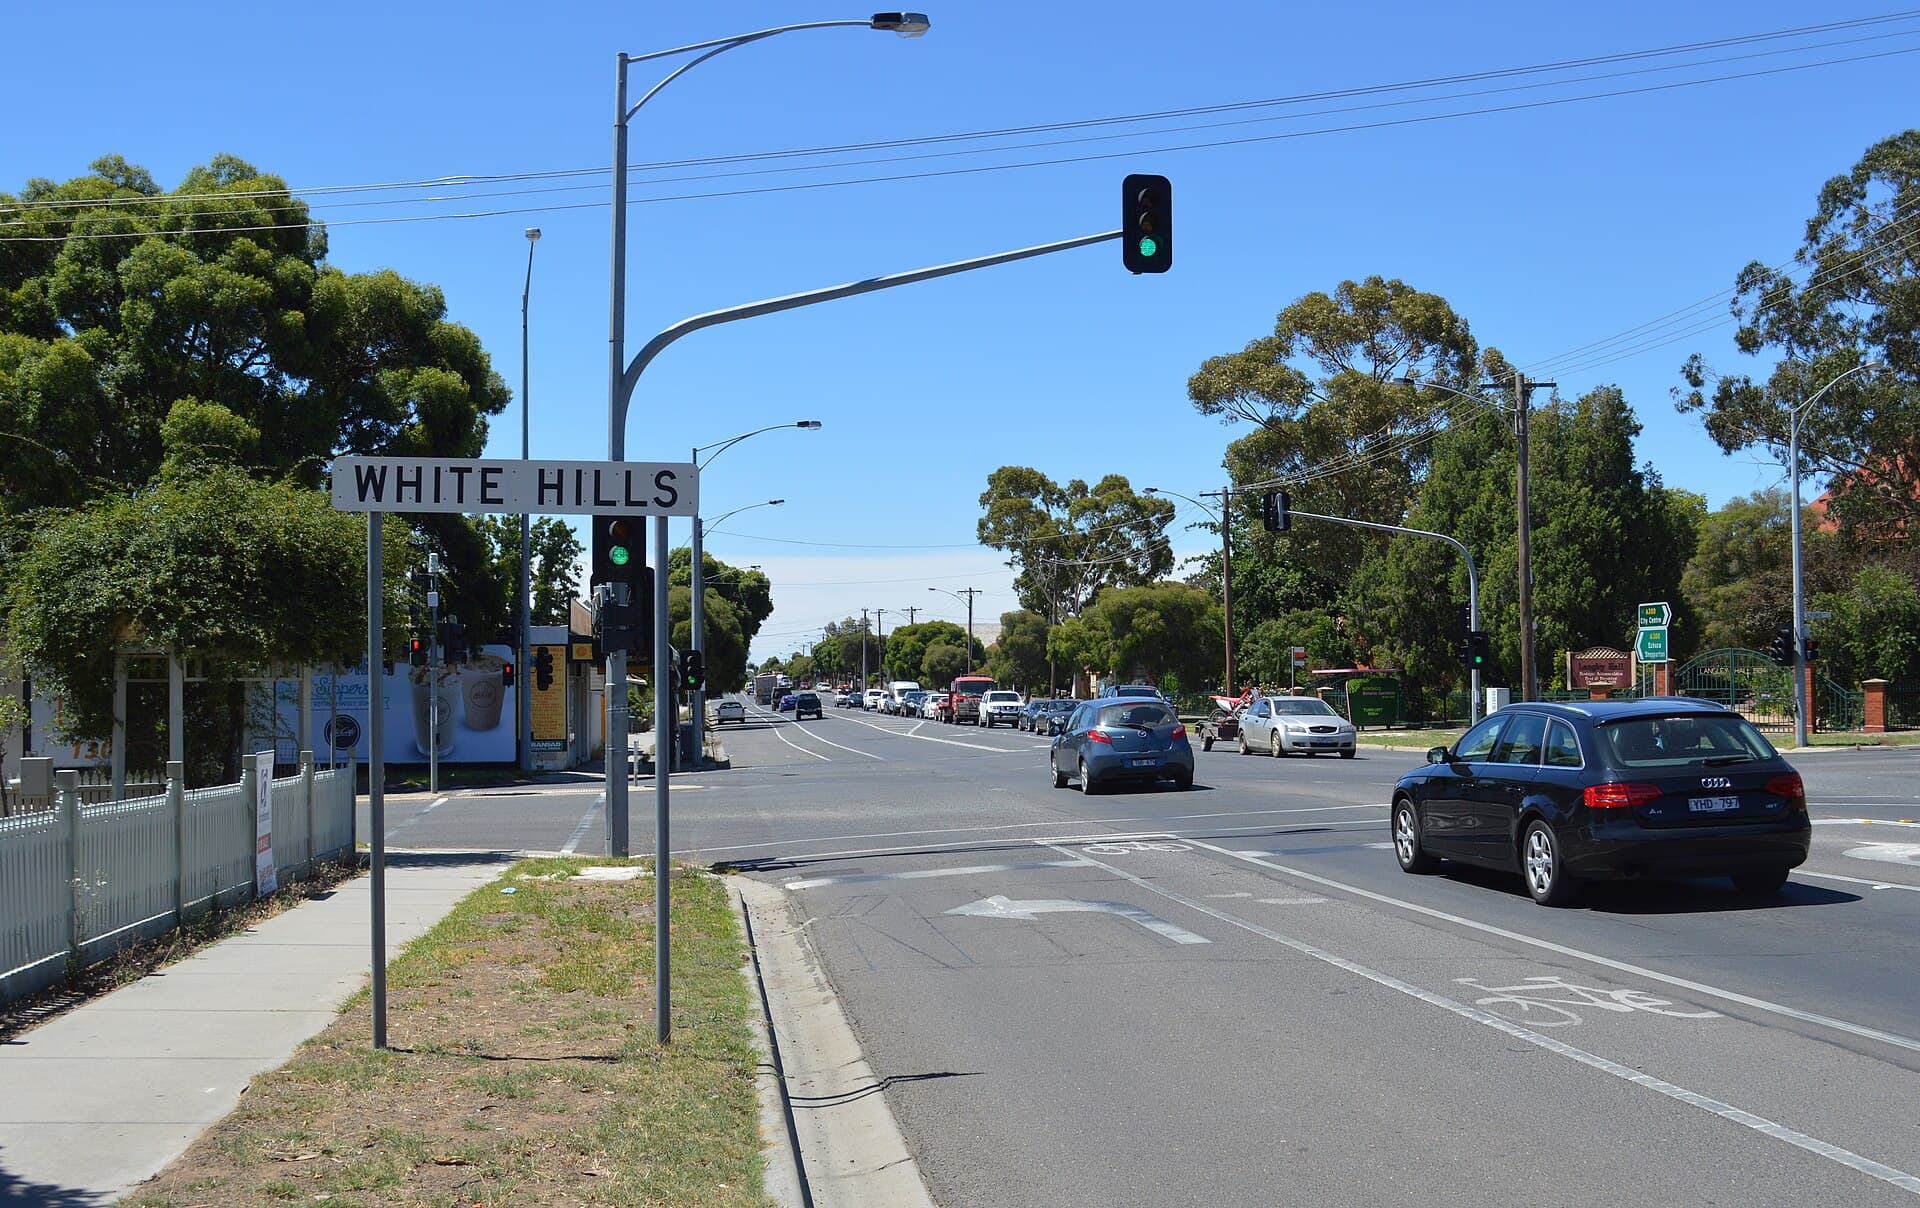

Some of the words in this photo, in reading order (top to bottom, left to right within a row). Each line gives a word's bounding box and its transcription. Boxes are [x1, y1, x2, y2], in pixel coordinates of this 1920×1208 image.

[354, 465, 504, 505] WHITE
[538, 468, 679, 508] HILLS
[1640, 617, 1648, 625] City
[1648, 616, 1662, 624] Centre
[1700, 667, 1729, 675] LANGLEY
